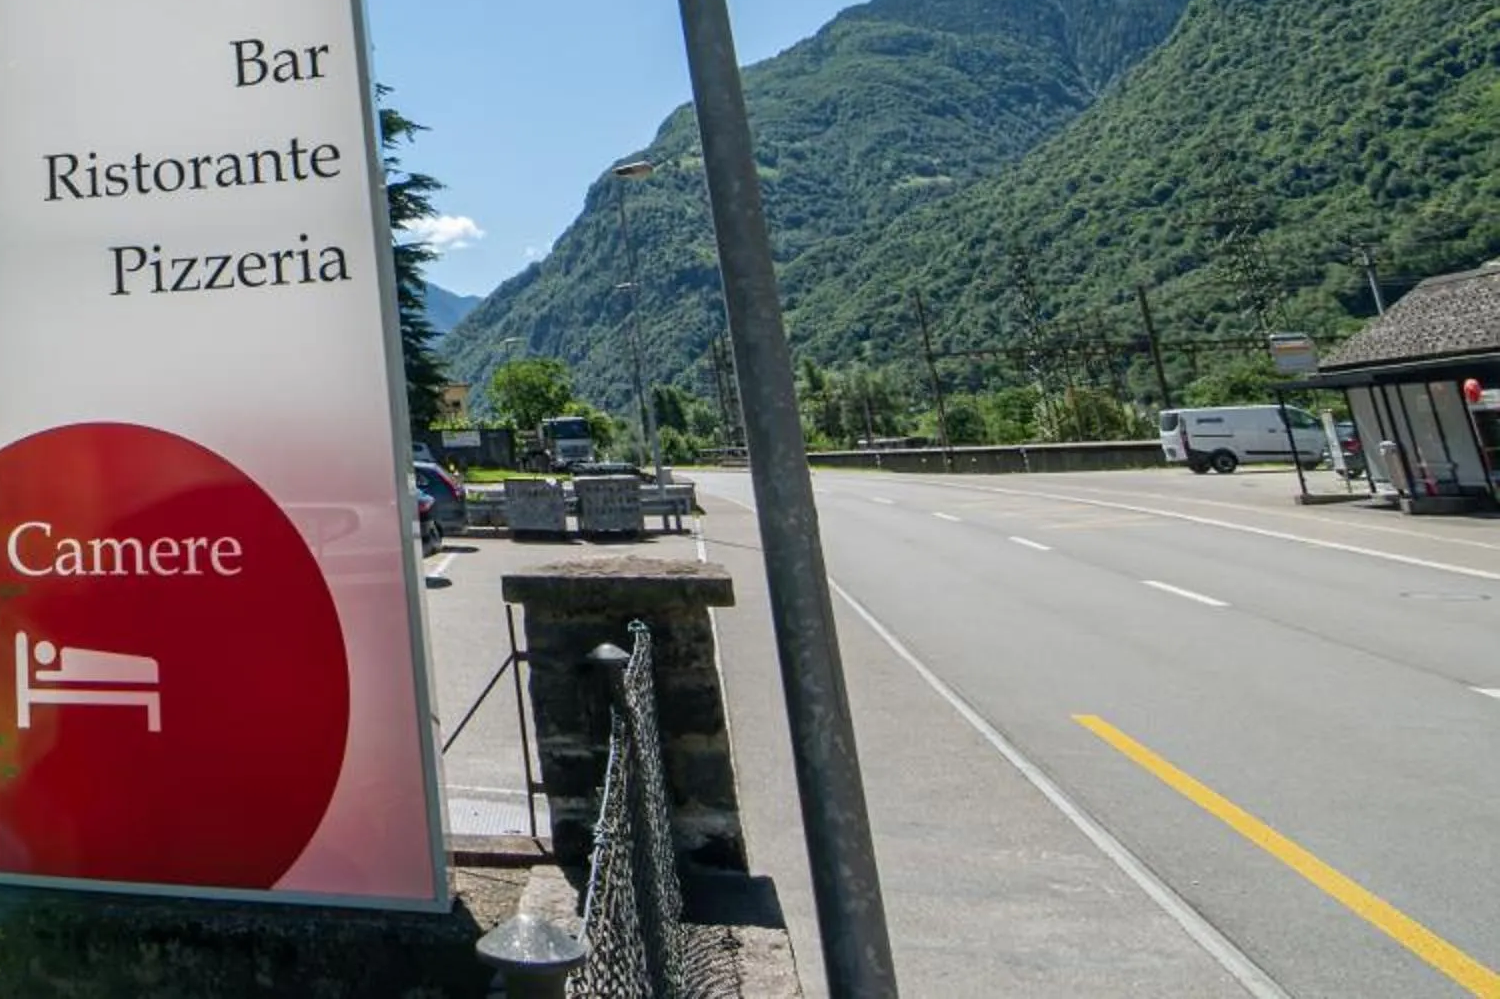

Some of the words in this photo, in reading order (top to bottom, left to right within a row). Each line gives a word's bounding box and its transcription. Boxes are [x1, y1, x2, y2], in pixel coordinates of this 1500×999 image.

[229, 37, 330, 87] Bar
[43, 137, 341, 202] Ristorante
[108, 232, 353, 296] Pizzeria
[7, 520, 243, 576] Camere
